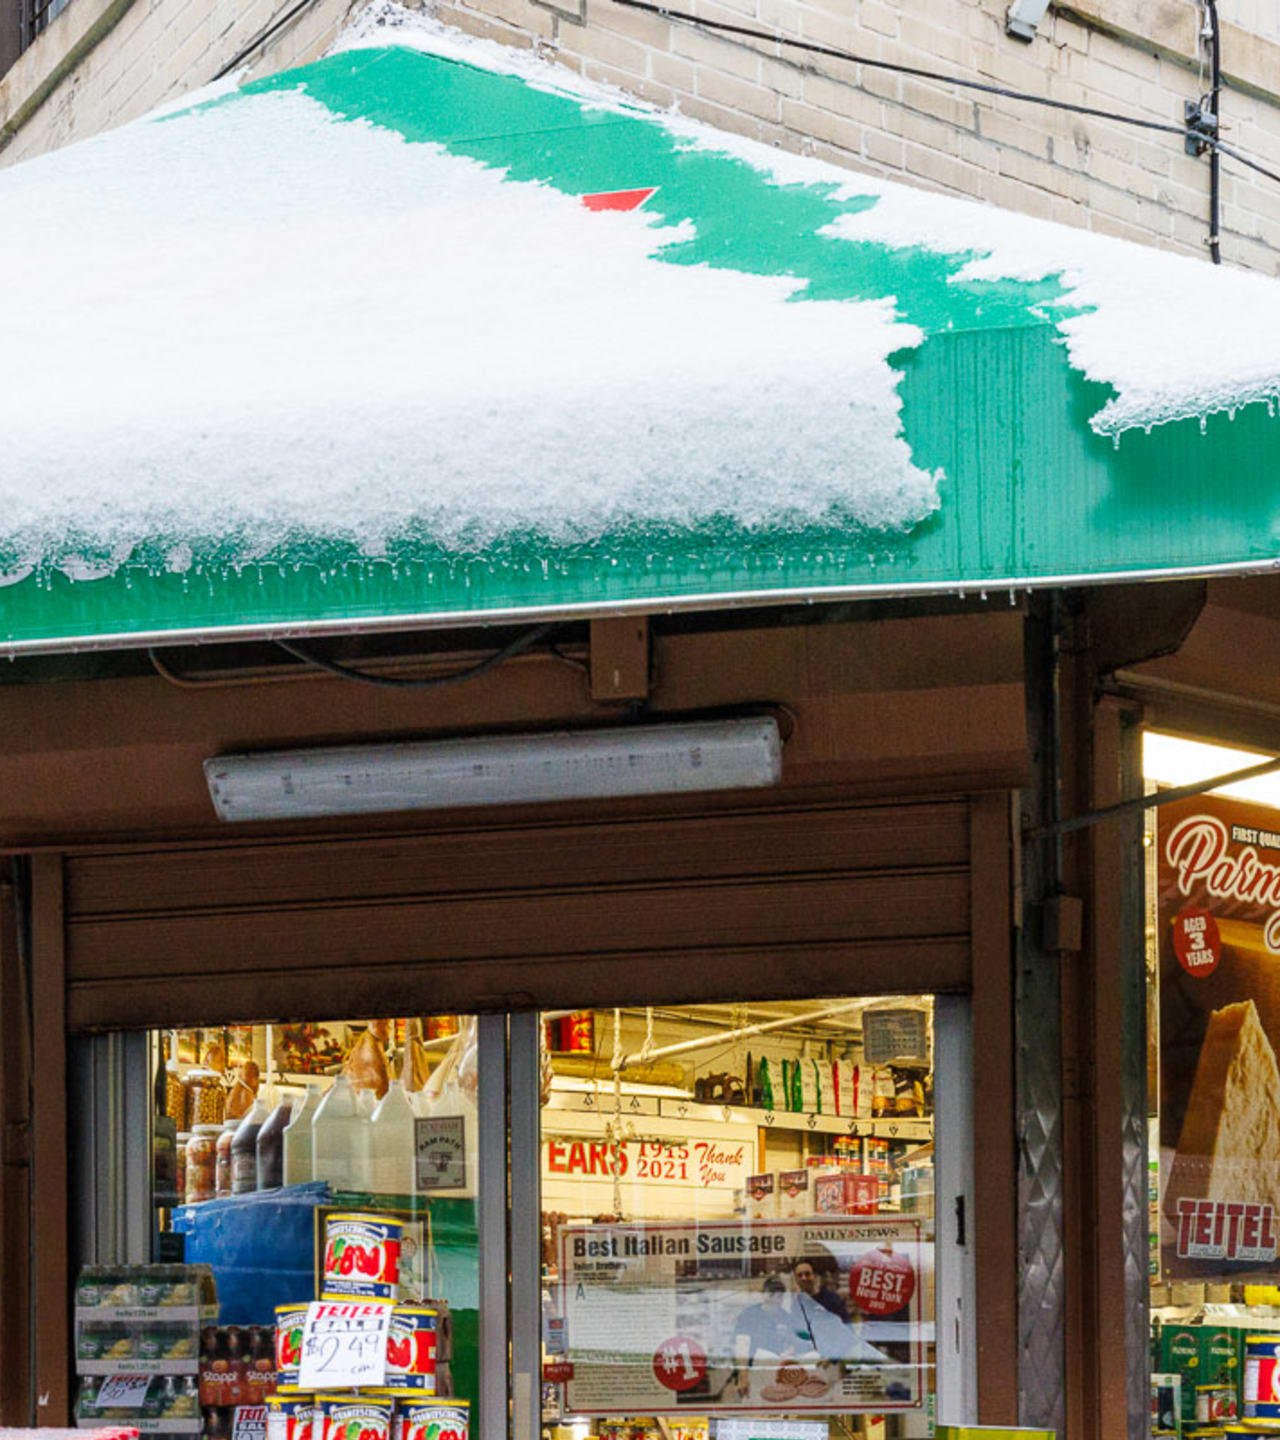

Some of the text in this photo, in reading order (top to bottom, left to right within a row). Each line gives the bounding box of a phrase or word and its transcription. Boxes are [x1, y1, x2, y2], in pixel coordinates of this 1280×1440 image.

[1232, 826, 1259, 843] FIRST
[1184, 917, 1207, 933] AGED
[1191, 933, 1206, 949] 3
[1186, 949, 1214, 967] YEARS
[695, 1142, 744, 1166] Thank
[637, 1158, 727, 1188] 2021 You
[1178, 1199, 1277, 1262] TEITEL
[573, 1228, 900, 1258] Best Italian Sausage DAILY NEWS
[859, 1269, 906, 1291] BEST
[855, 1286, 903, 1304] New York
[315, 1305, 385, 1320] TEITEL
[662, 1342, 699, 1381] #1
